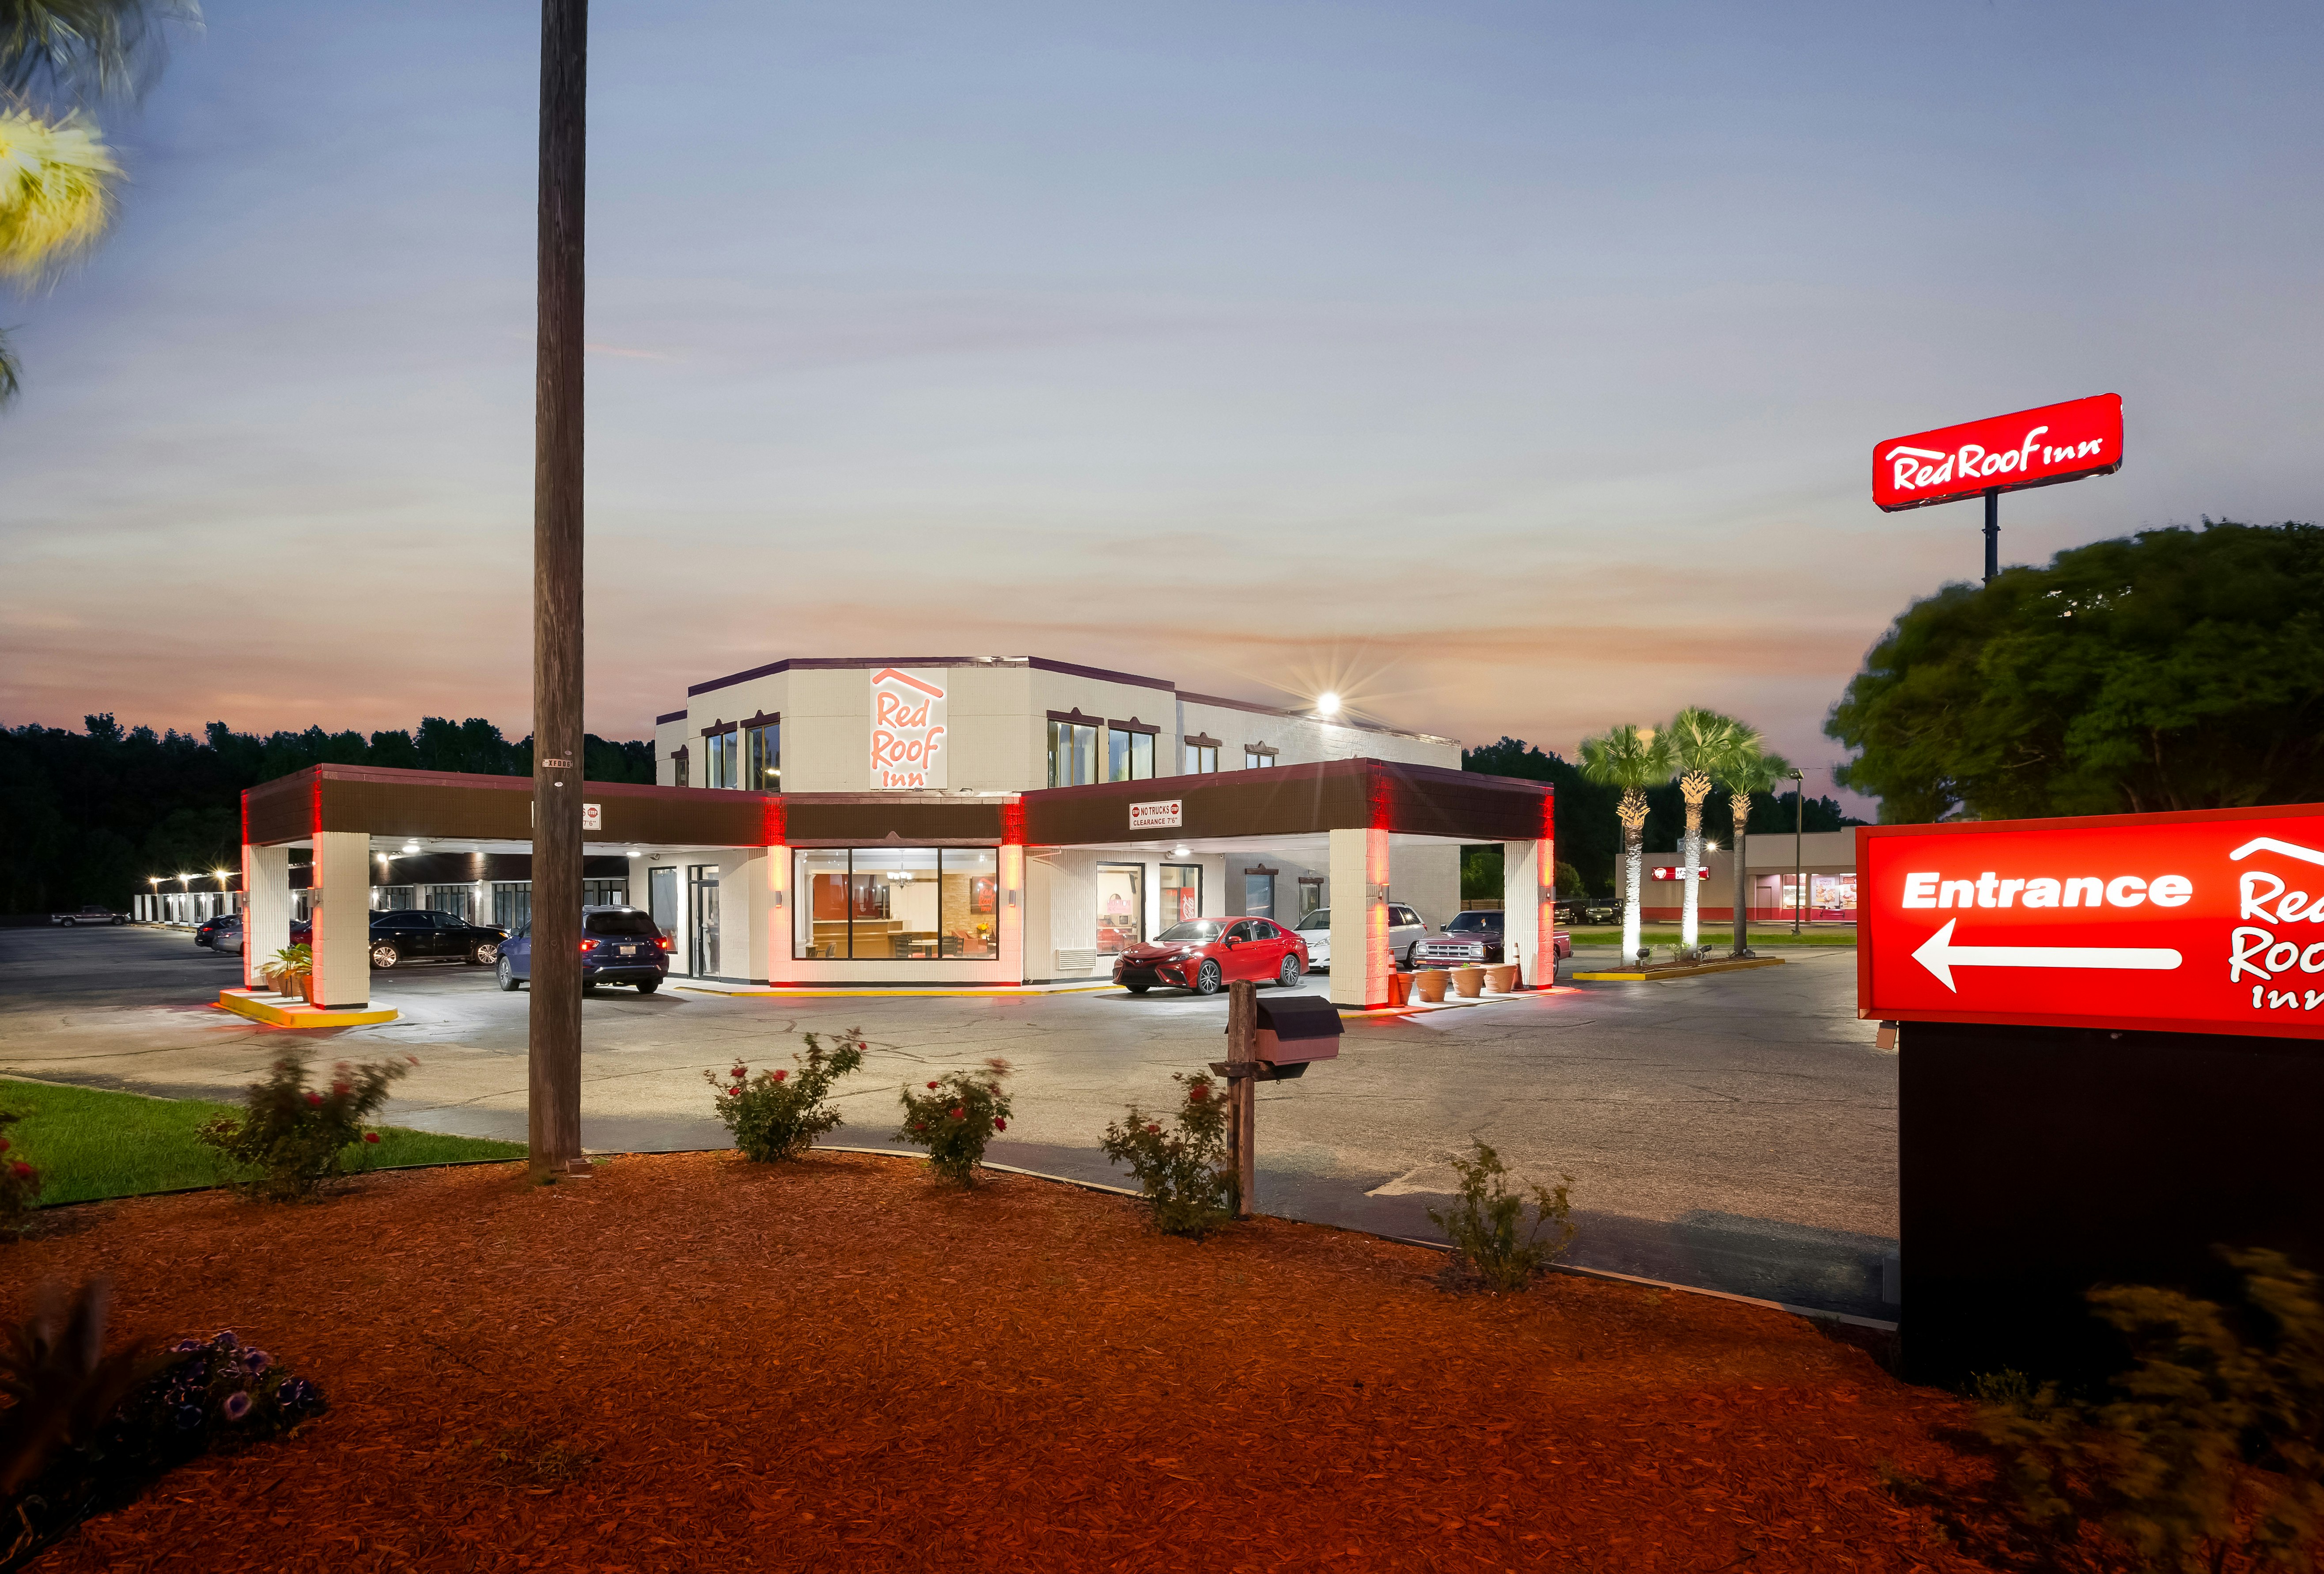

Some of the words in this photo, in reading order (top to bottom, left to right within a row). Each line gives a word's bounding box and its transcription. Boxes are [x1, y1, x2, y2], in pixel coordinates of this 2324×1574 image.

[1894, 454, 1955, 489] Red
[1959, 426, 2048, 478] Roof
[877, 692, 930, 728] Red
[871, 727, 944, 769] Roof
[1141, 807, 1148, 816] NO
[1149, 805, 1170, 815] TRUCKS
[1902, 872, 2192, 908] Entrance
[2228, 926, 2324, 983] Roo
